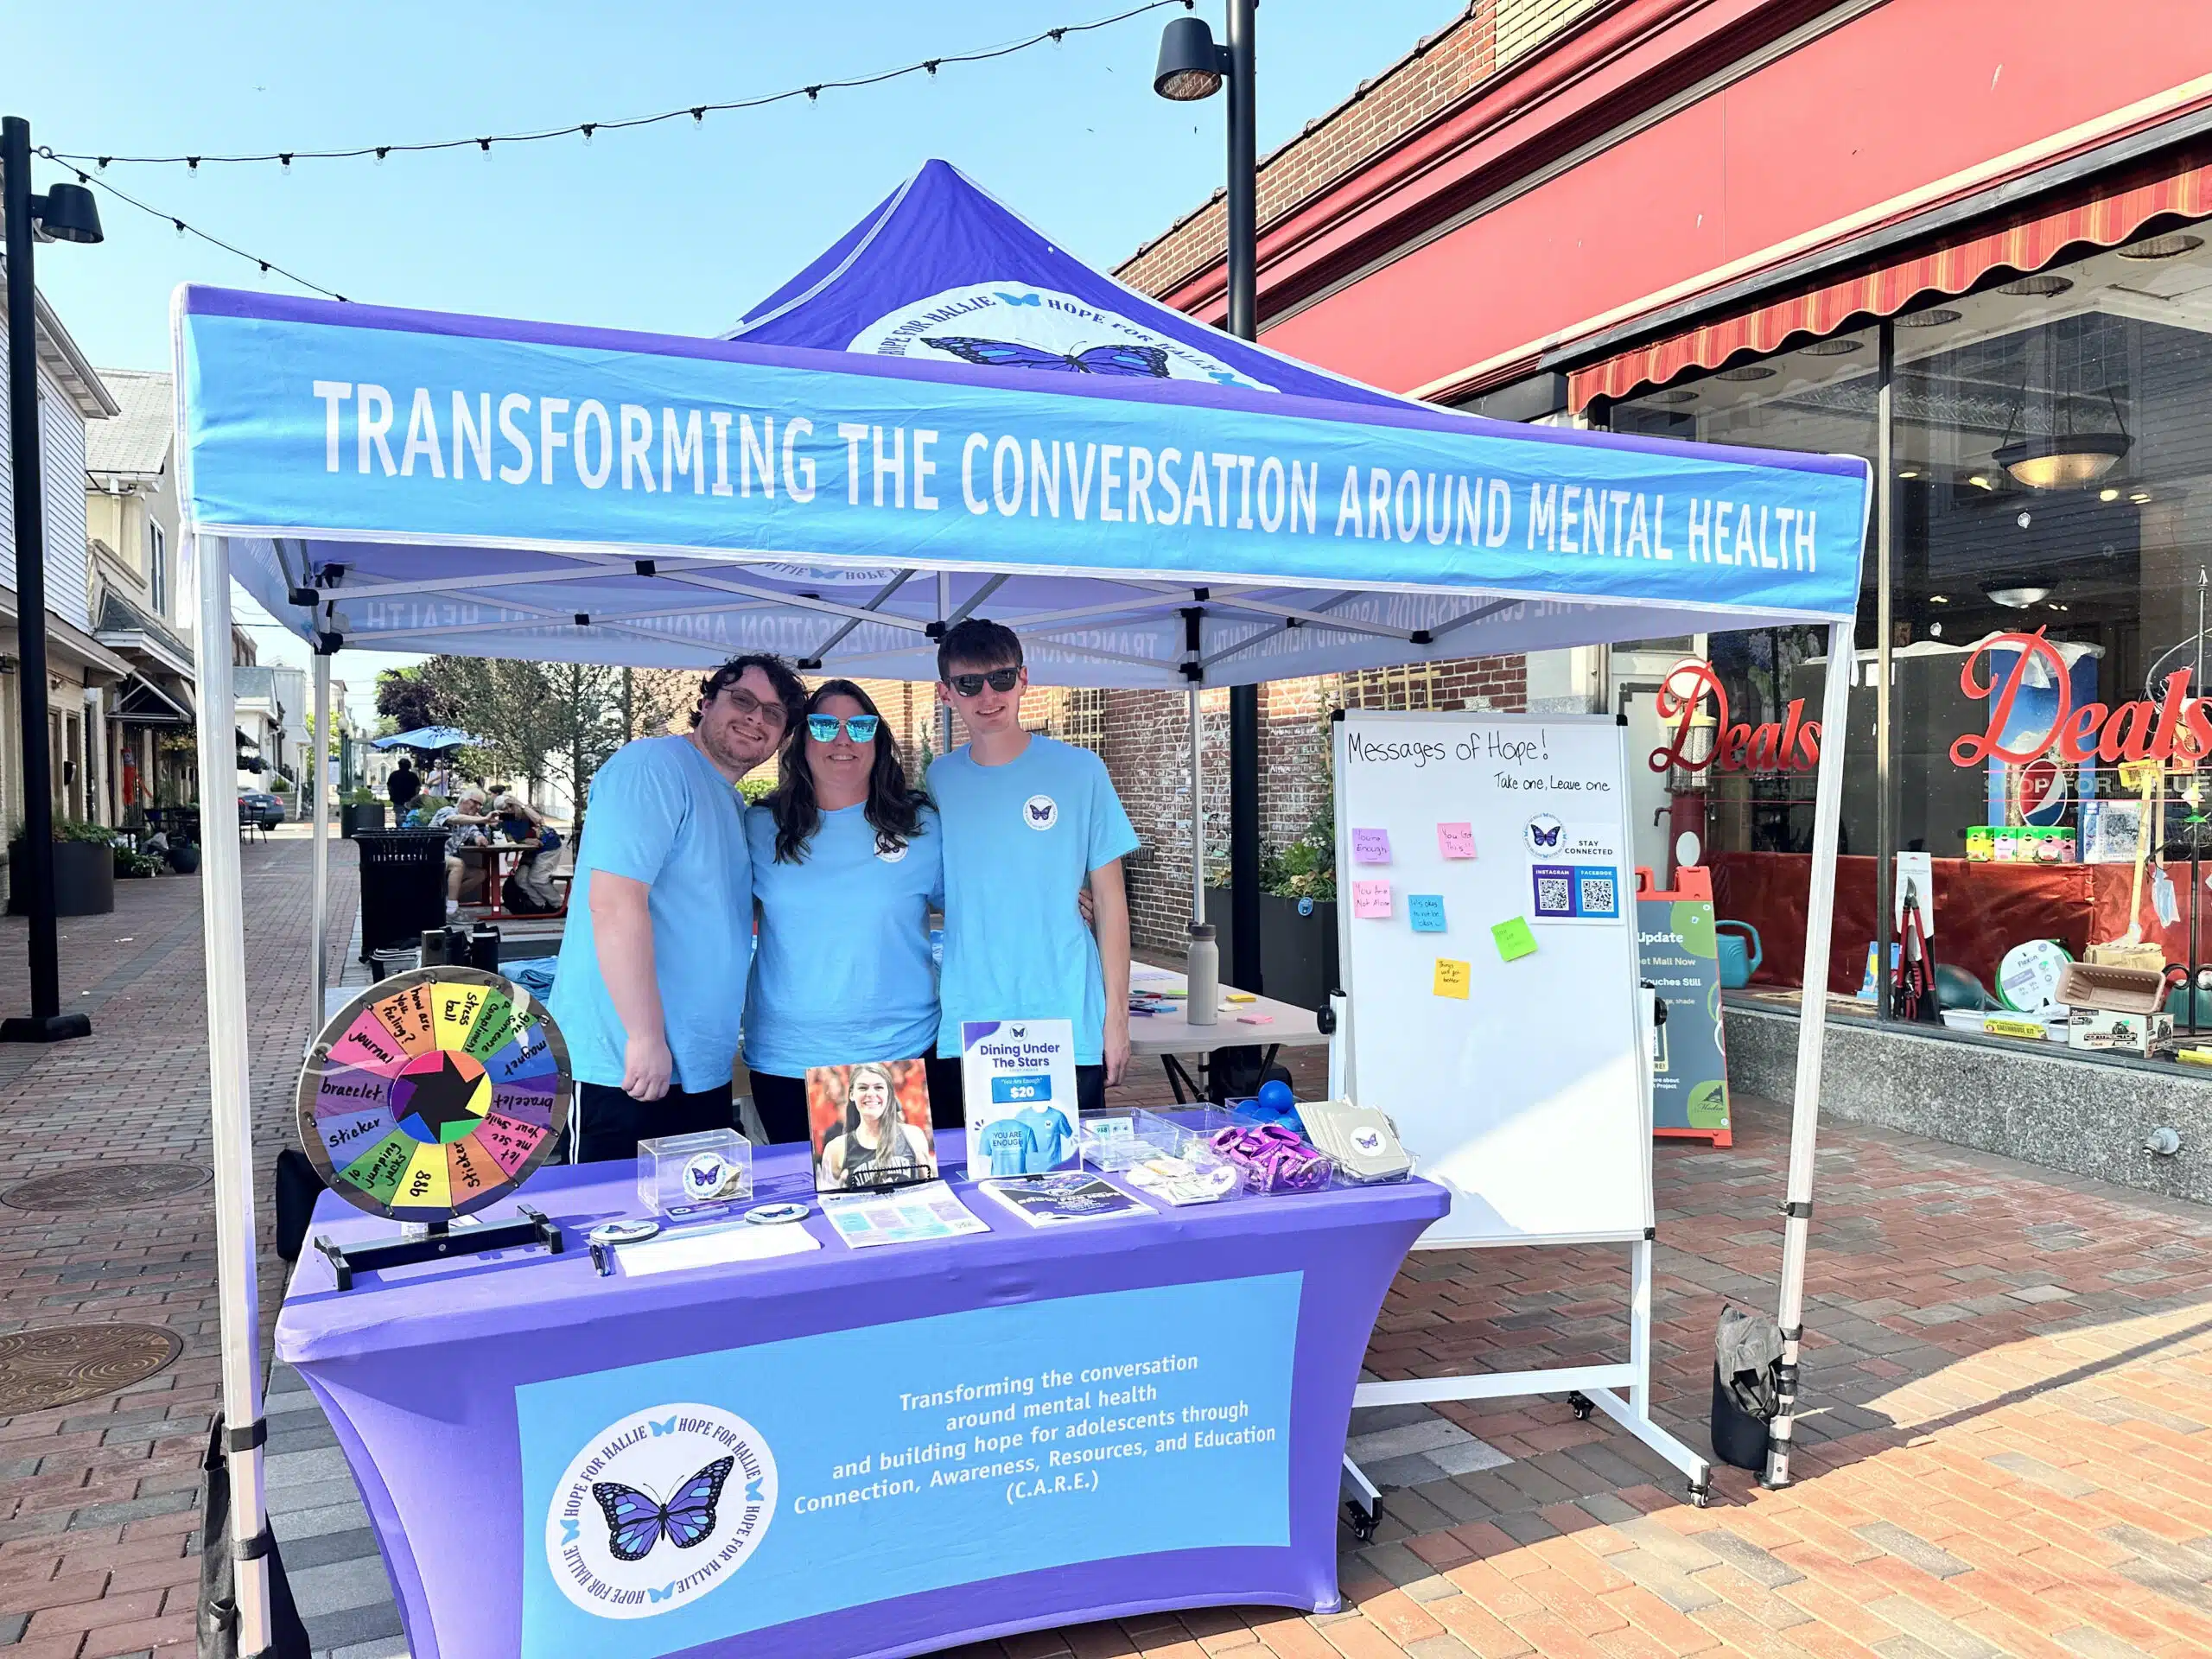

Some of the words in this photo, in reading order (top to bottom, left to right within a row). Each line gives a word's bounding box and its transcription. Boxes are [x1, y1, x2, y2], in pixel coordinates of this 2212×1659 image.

[892, 321, 933, 336] FOR
[922, 296, 996, 321] HALLIE
[1047, 298, 1105, 324] HOPE
[1112, 323, 1154, 342] FOR
[1155, 342, 1223, 372] HALLIE
[313, 380, 815, 503] TRANSFORMING
[838, 422, 939, 511] THE
[962, 432, 1319, 536] CONVERSATION
[1335, 465, 1512, 548] AROUND
[1527, 482, 1674, 561] MENTAL
[1688, 498, 1817, 573] HEALTH
[1948, 624, 2212, 767] Deals
[1649, 660, 1821, 772] Deals
[1348, 733, 1446, 768] Messages
[1456, 734, 1480, 759] of
[1488, 729, 1548, 765] Hope!
[1494, 772, 1518, 790] Take
[1523, 779, 1548, 791] one,
[1550, 775, 1581, 791] Leave
[1586, 780, 1611, 791] one
[1637, 932, 1684, 945] Update
[1652, 957, 1673, 966] Mall
[1675, 957, 1696, 966] Now
[1682, 977, 1701, 987] Still
[391, 994, 410, 1014] you
[410, 986, 423, 1013] how
[418, 1012, 430, 1033] are
[444, 1000, 461, 1022] ball
[383, 1006, 416, 1044] feeling?
[464, 1003, 499, 1053] compliment
[482, 1015, 516, 1052] someone
[512, 1012, 530, 1035] give
[348, 1025, 395, 1065] journal
[504, 1039, 547, 1077] magnet
[980, 1044, 1021, 1057] Dining
[1023, 1043, 1060, 1053] Under
[992, 1058, 1015, 1068] The
[1017, 1057, 1050, 1067] Stars
[321, 1077, 383, 1101] bracelet
[493, 1091, 553, 1113] bracelet
[1010, 1086, 1035, 1099] $20
[501, 1148, 519, 1165] let
[514, 1139, 533, 1150] me
[361, 1141, 403, 1189] jumping
[386, 1154, 408, 1187] jacks
[899, 1374, 1034, 1412] Transforming
[1041, 1369, 1073, 1389] the
[1080, 1353, 1199, 1384] conversation
[945, 1402, 1016, 1432] around
[1022, 1393, 1092, 1418] mental
[1097, 1384, 1158, 1408] health
[677, 1417, 714, 1436] HOPE
[712, 1426, 737, 1448] FOR
[732, 1440, 761, 1480] HALLIE
[832, 1457, 872, 1480] and
[879, 1438, 968, 1471] building
[973, 1431, 1024, 1459] hope
[1029, 1425, 1058, 1444] for
[1065, 1408, 1176, 1440] adolescents
[1180, 1400, 1249, 1426] through
[564, 1483, 587, 1517] HOPE
[580, 1457, 606, 1485] FOR
[601, 1426, 647, 1460] HALLIE
[793, 1477, 922, 1515] Connection,
[930, 1457, 1041, 1490] Awareness,
[1048, 1440, 1148, 1469] Resources,
[1154, 1433, 1188, 1453] and
[1194, 1426, 1276, 1448] Education
[1006, 1470, 1100, 1505] (C.A.R.E.)
[735, 1505, 760, 1538] HOPE
[718, 1535, 744, 1561] FOR
[563, 1545, 594, 1587] HALLIE
[677, 1560, 722, 1593] HALLIE
[587, 1577, 612, 1600] FOR
[610, 1586, 645, 1605] HOPE
